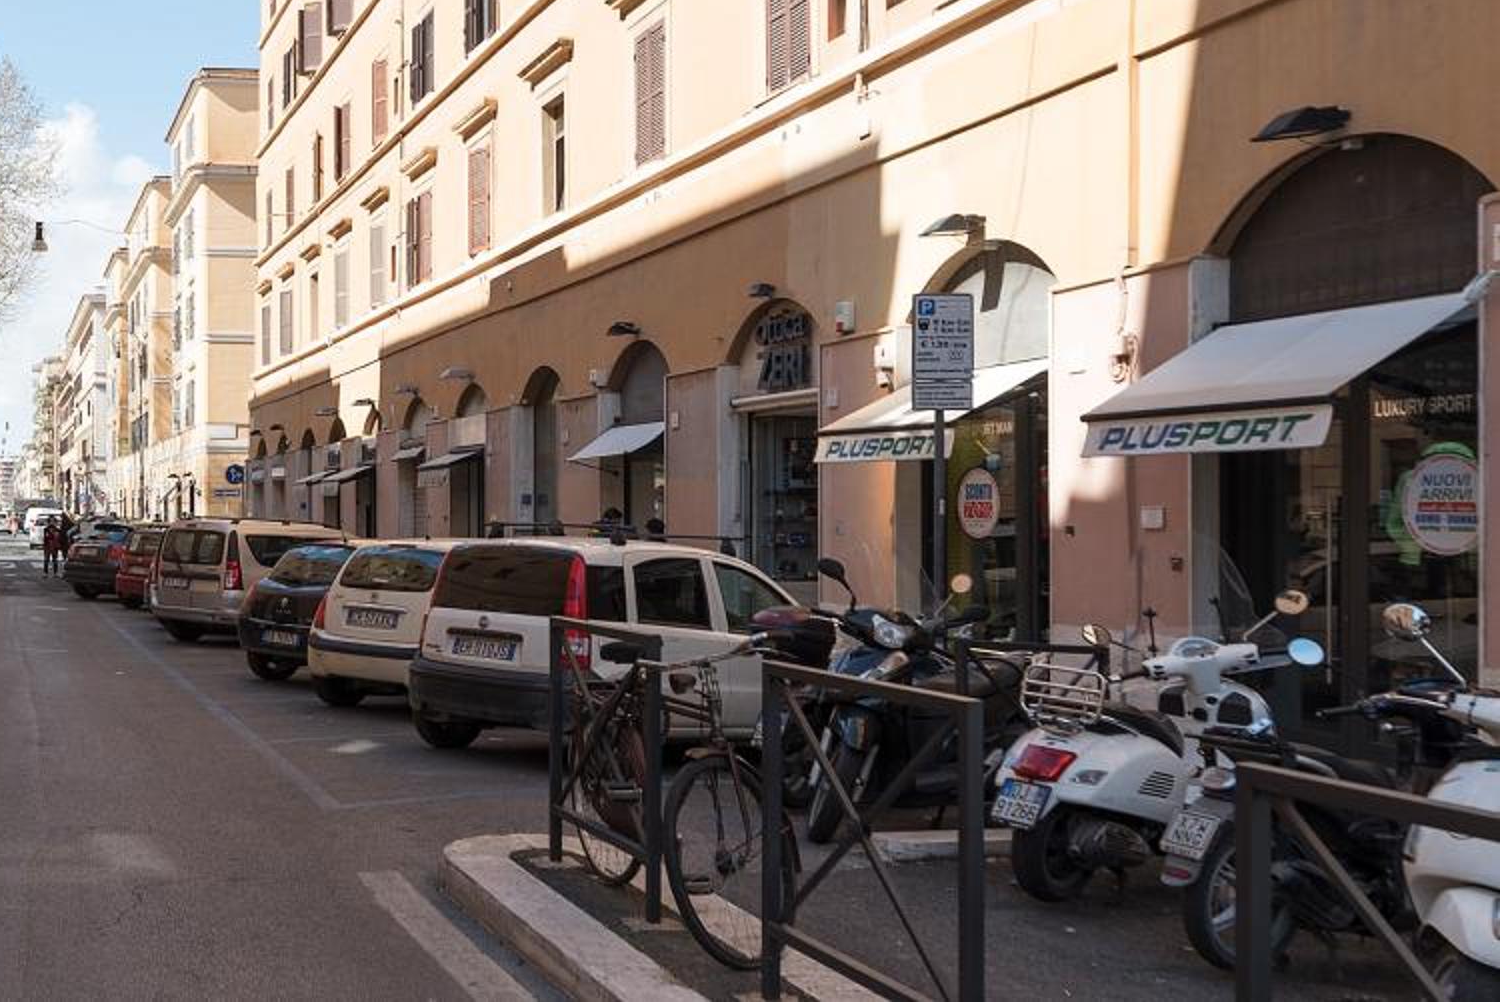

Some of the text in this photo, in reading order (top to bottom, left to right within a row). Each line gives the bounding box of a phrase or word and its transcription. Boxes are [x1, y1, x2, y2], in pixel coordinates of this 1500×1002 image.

[756, 348, 804, 391] ZERI
[1374, 393, 1474, 417] LUXURY SPORT
[1097, 413, 1316, 450] PLUSPORT
[1421, 474, 1473, 487] NUOVI
